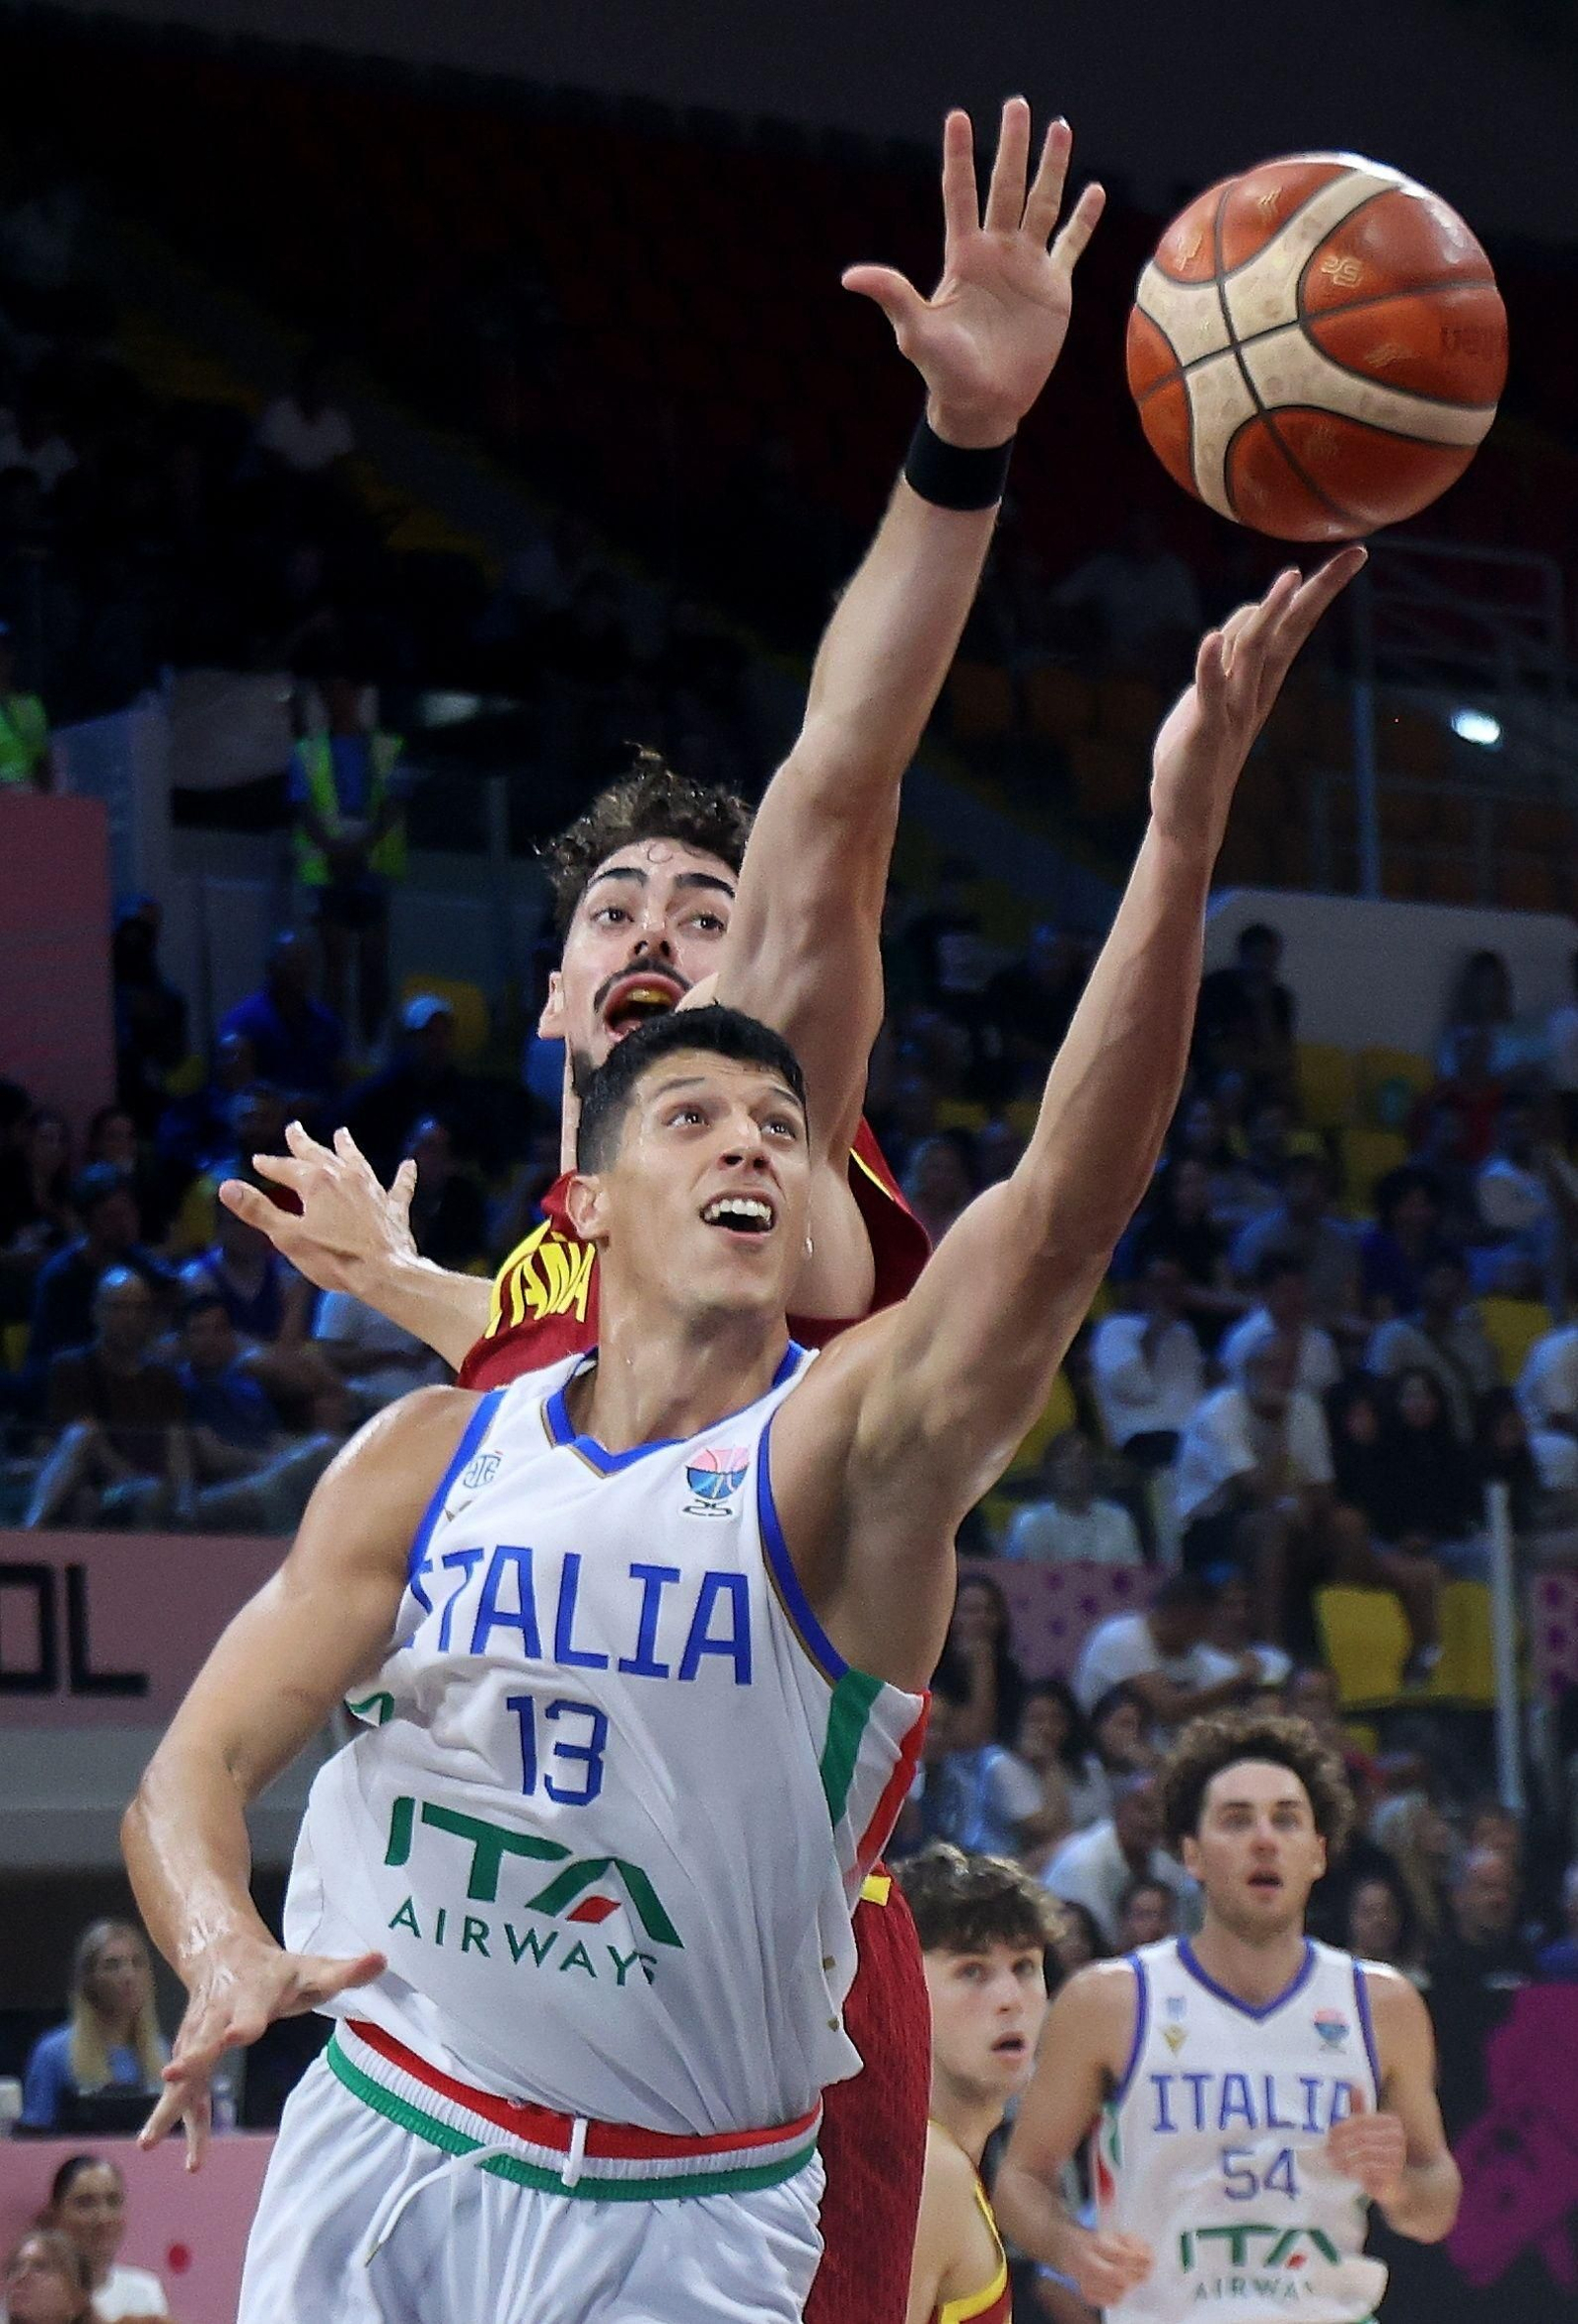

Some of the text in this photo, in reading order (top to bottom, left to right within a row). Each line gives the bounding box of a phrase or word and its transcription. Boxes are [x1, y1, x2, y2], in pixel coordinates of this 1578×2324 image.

[506, 1694, 609, 1806] 13
[384, 1796, 685, 1949] ITA
[1222, 2145, 1300, 2202] 54
[1180, 2223, 1341, 2275] ITA
